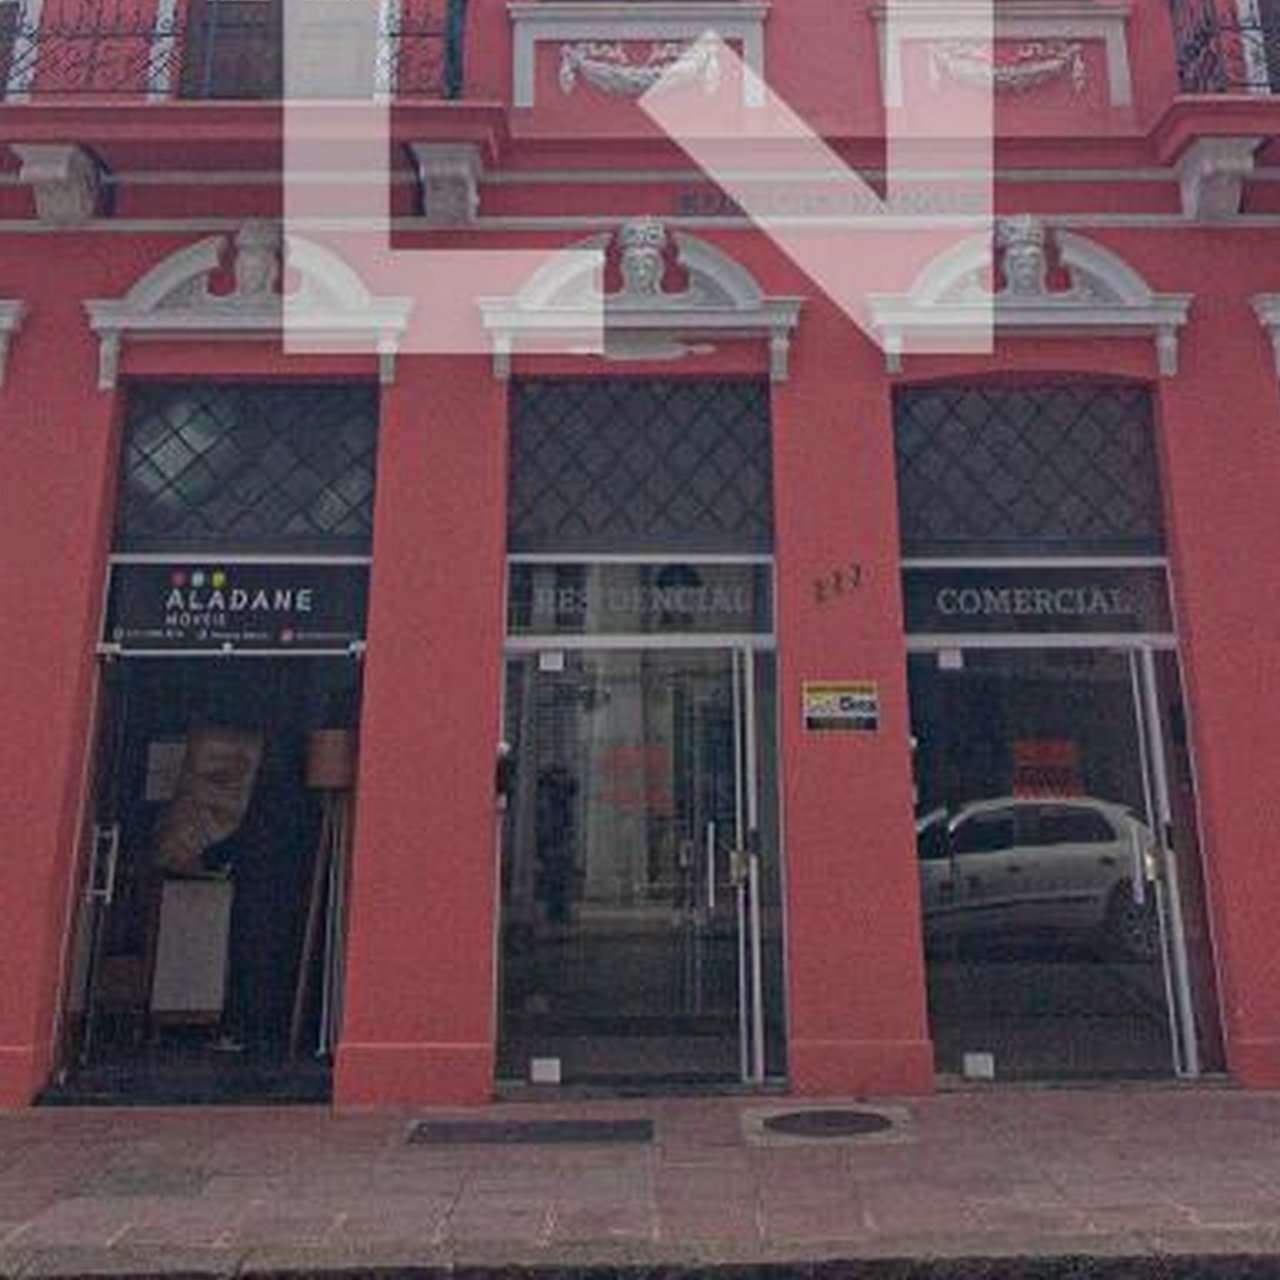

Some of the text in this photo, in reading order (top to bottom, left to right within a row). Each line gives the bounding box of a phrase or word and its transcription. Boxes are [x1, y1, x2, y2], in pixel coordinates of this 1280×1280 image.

[166, 588, 313, 611] ALADANE
[534, 584, 754, 614] RESDENCIAL
[935, 587, 1133, 616] COMERCIAL
